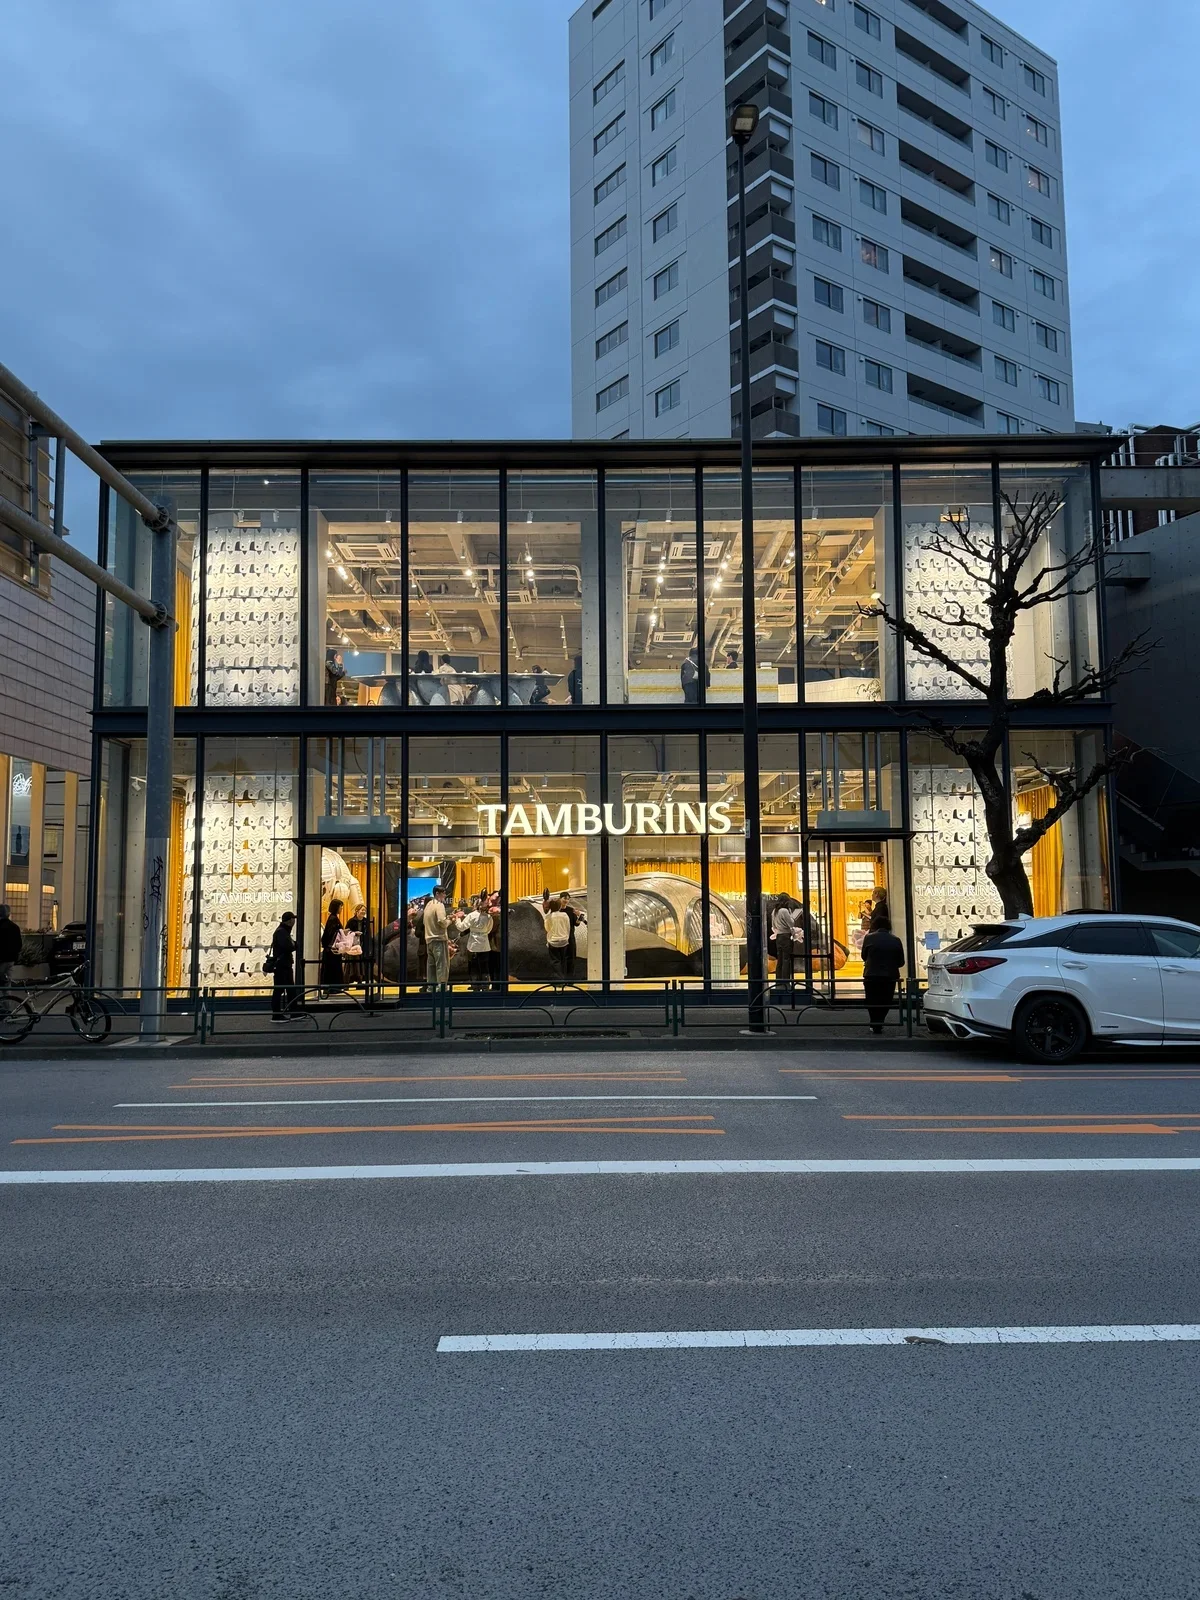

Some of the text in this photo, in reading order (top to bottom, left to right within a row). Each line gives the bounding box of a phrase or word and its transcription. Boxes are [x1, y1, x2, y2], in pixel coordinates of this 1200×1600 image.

[478, 802, 731, 836] TAMBURINS
[212, 891, 293, 904] TAMBURINS
[915, 885, 998, 897] TAMBURINS
